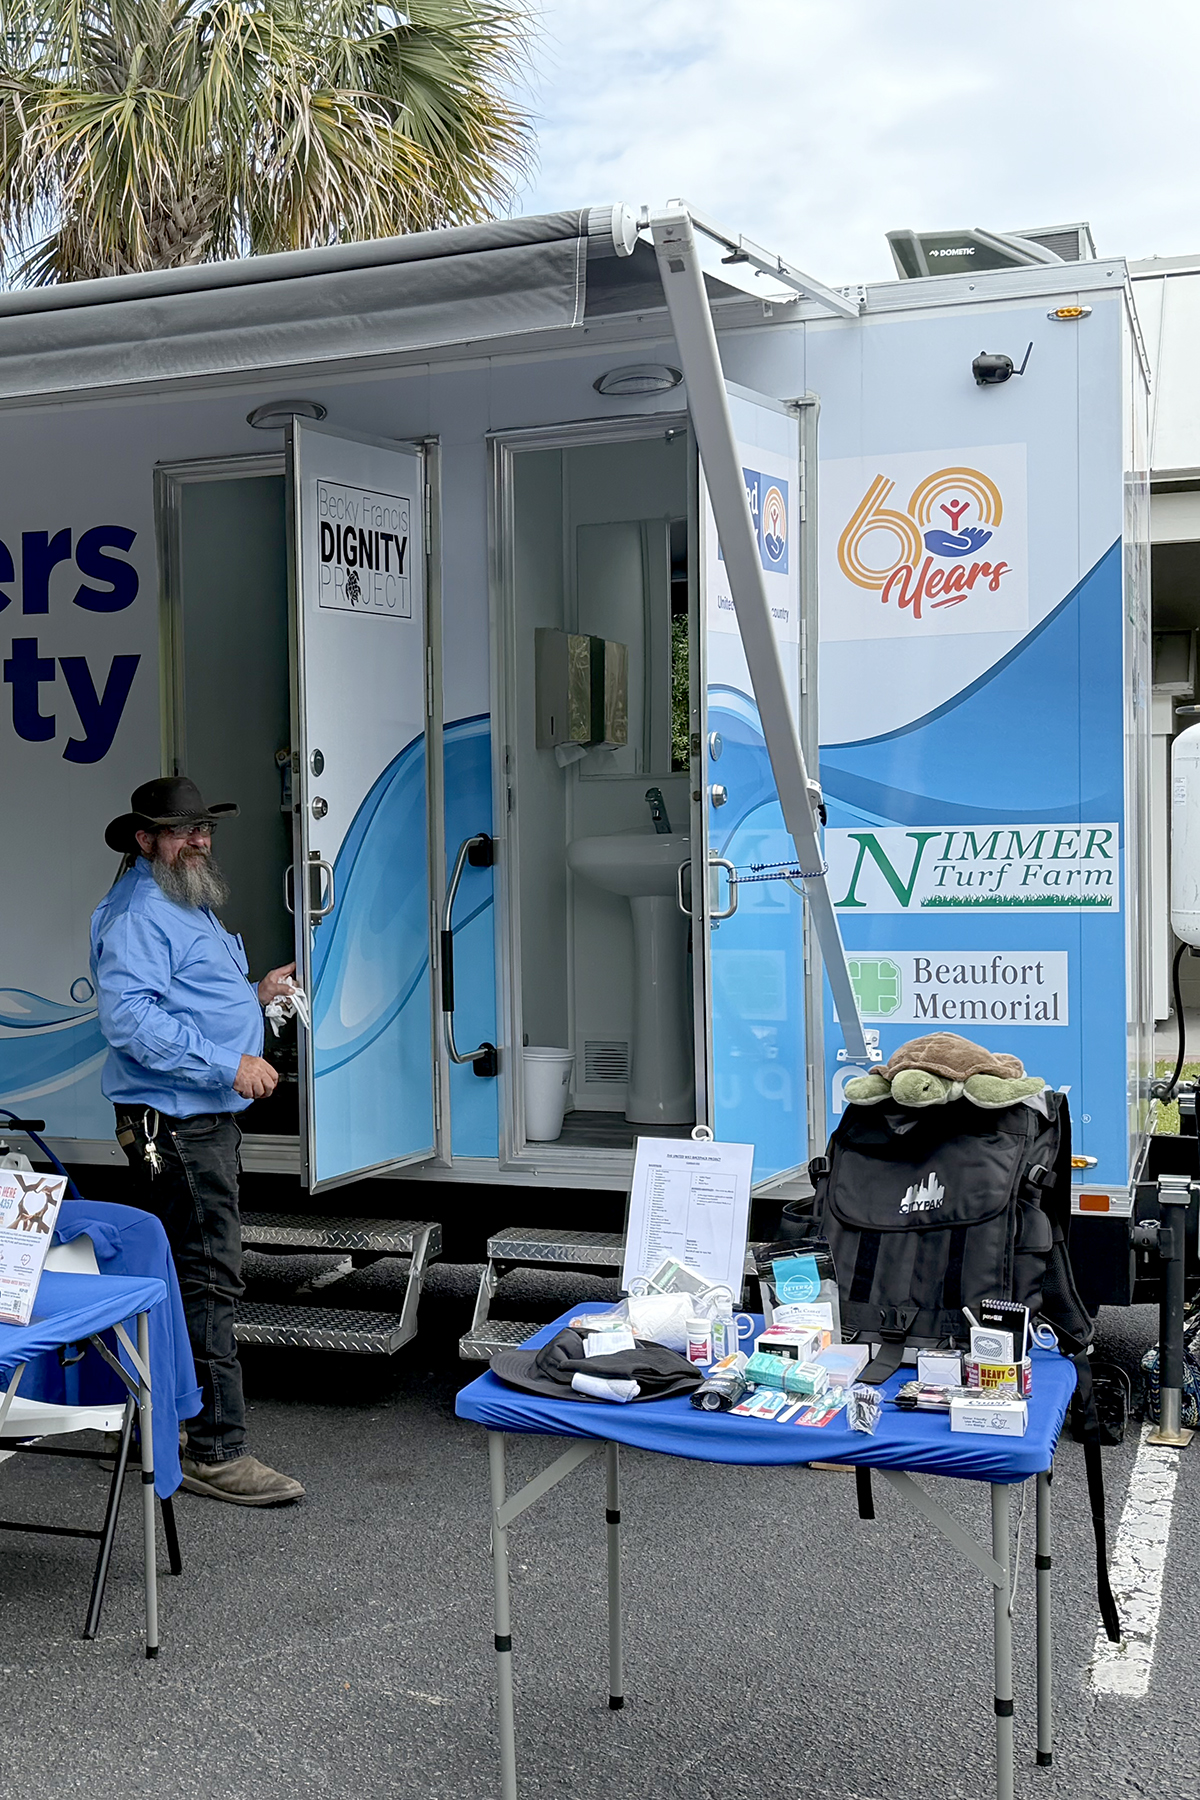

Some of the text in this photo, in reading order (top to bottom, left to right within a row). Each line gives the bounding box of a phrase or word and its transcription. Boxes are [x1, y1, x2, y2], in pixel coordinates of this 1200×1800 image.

[940, 247, 976, 257] DOMETIC
[320, 488, 409, 533] Becky Francis
[320, 520, 408, 575] DIGNITY
[320, 564, 408, 610] PRJECT
[881, 556, 1013, 619] Years
[833, 828, 1114, 908] NIMMER
[933, 862, 1114, 892] Turf Farm
[912, 955, 1045, 985] Beaufort
[912, 992, 1060, 1021] Memorial
[2, 1186, 18, 1199] HERE
[900, 1198, 944, 1215] CITYPAK
[980, 1368, 1006, 1380] HEAVY
[980, 1379, 998, 1387] DUTY
